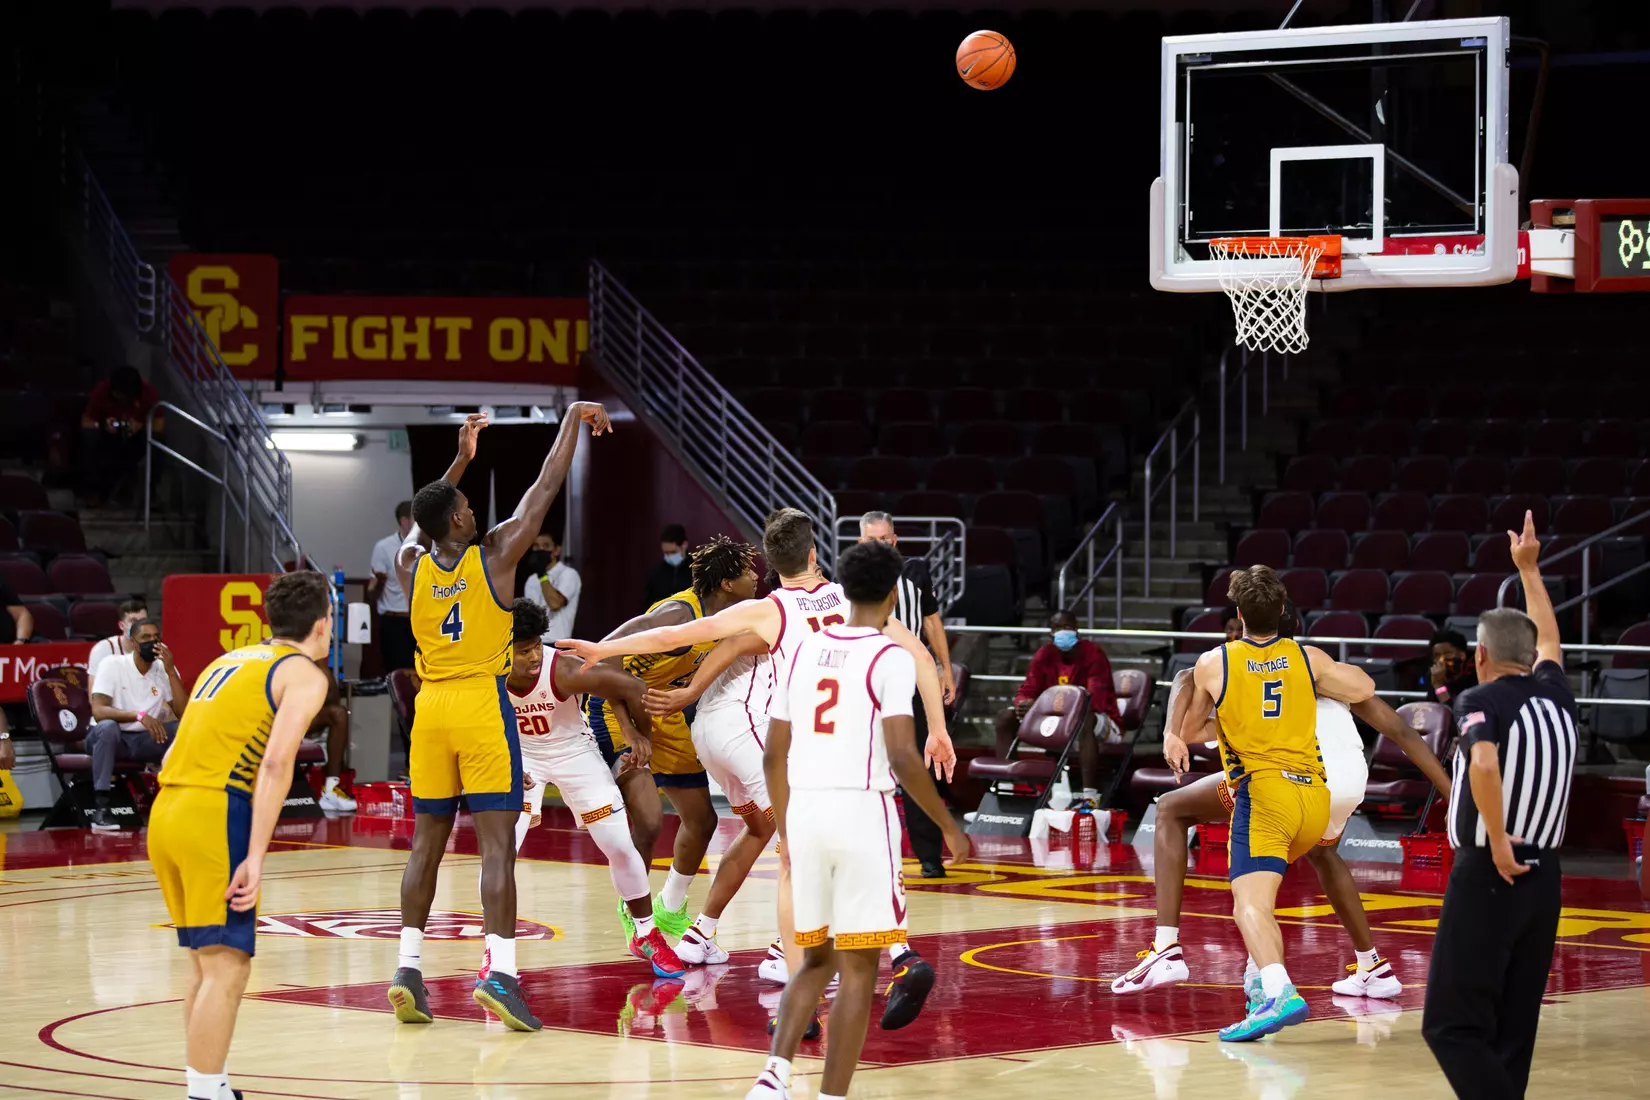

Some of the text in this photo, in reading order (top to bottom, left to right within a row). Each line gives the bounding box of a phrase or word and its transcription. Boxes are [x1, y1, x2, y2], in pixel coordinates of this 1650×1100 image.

[187, 265, 259, 366] SC
[291, 315, 589, 367] FIGHT ON!
[432, 578, 467, 599] THOMAS
[796, 592, 841, 611] PETERSON
[440, 600, 464, 643] 4
[1247, 656, 1289, 673] NOTTAGE
[190, 663, 243, 702] 11
[514, 702, 556, 715] OJANS
[814, 678, 840, 735] 2
[1262, 678, 1284, 719] 5
[516, 715, 552, 736] 20
[977, 813, 1025, 825] POWERADE
